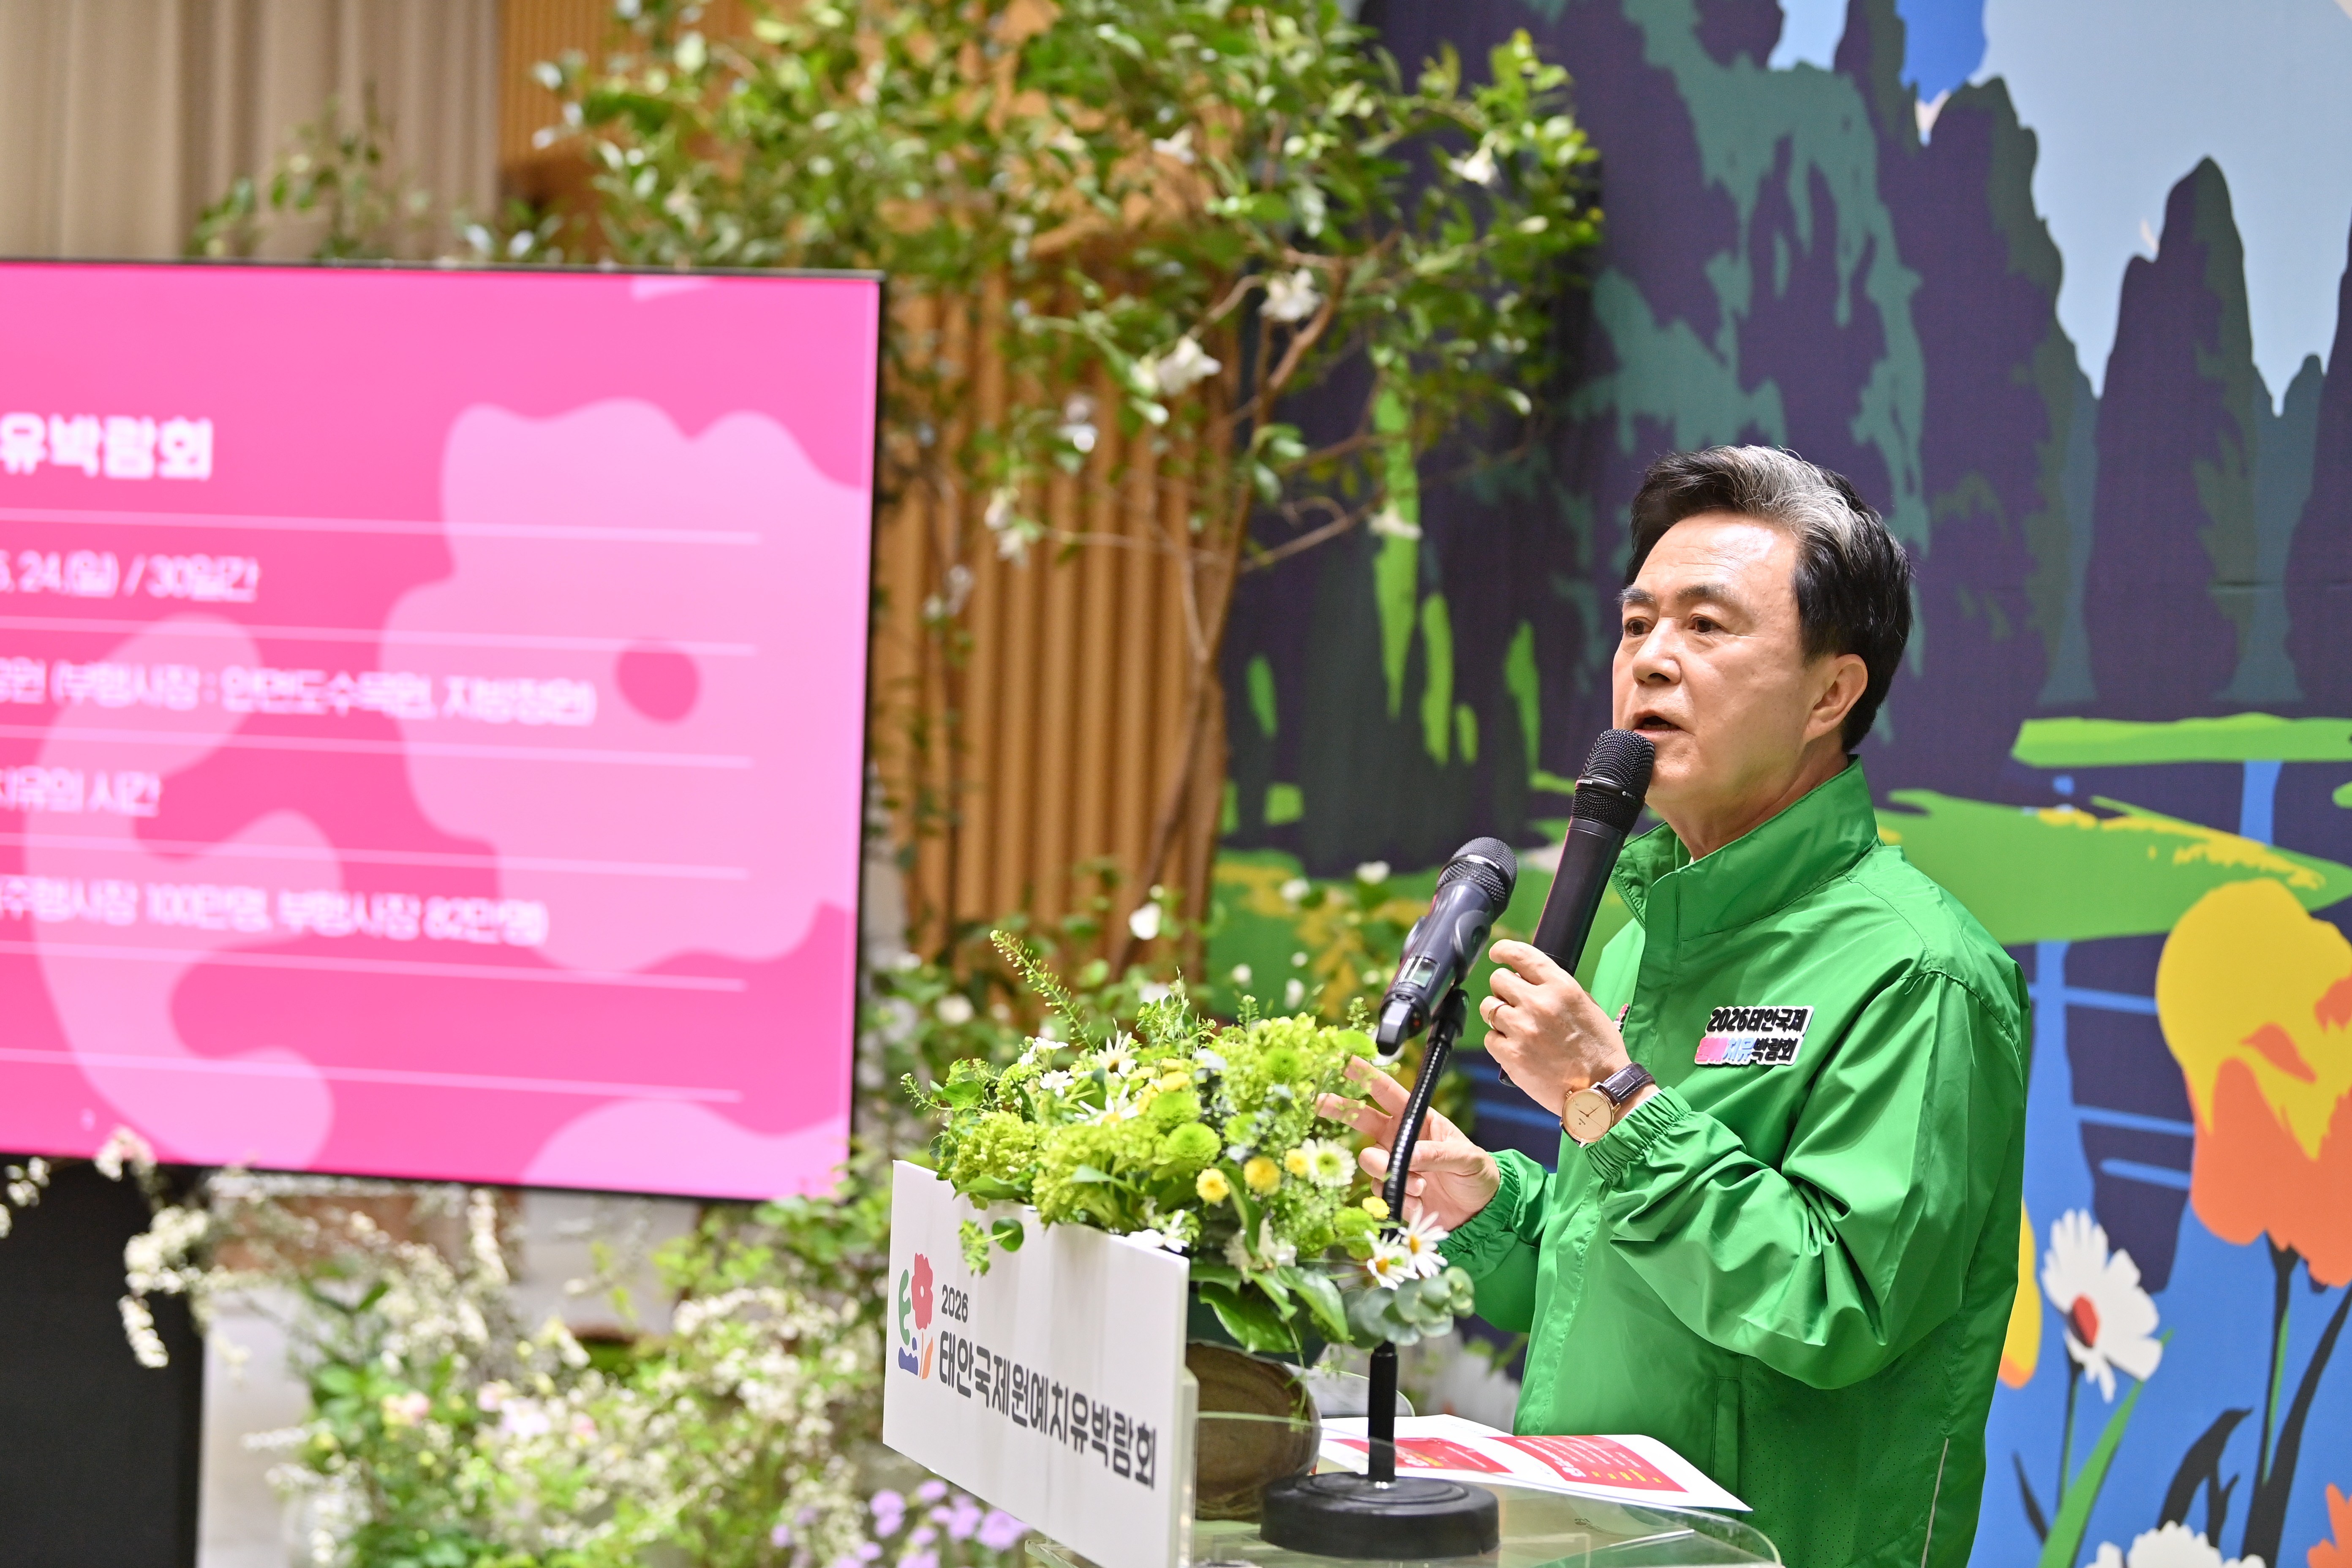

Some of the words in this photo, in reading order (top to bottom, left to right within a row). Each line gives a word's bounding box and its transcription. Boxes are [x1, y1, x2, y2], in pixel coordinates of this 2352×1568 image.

[1707, 1008, 1808, 1032] 2026태안국제
[1695, 1037, 1798, 1061] 원치유박람회
[941, 1284, 968, 1323] 2026
[939, 1331, 1156, 1490] 태안국제원예치유박람회
